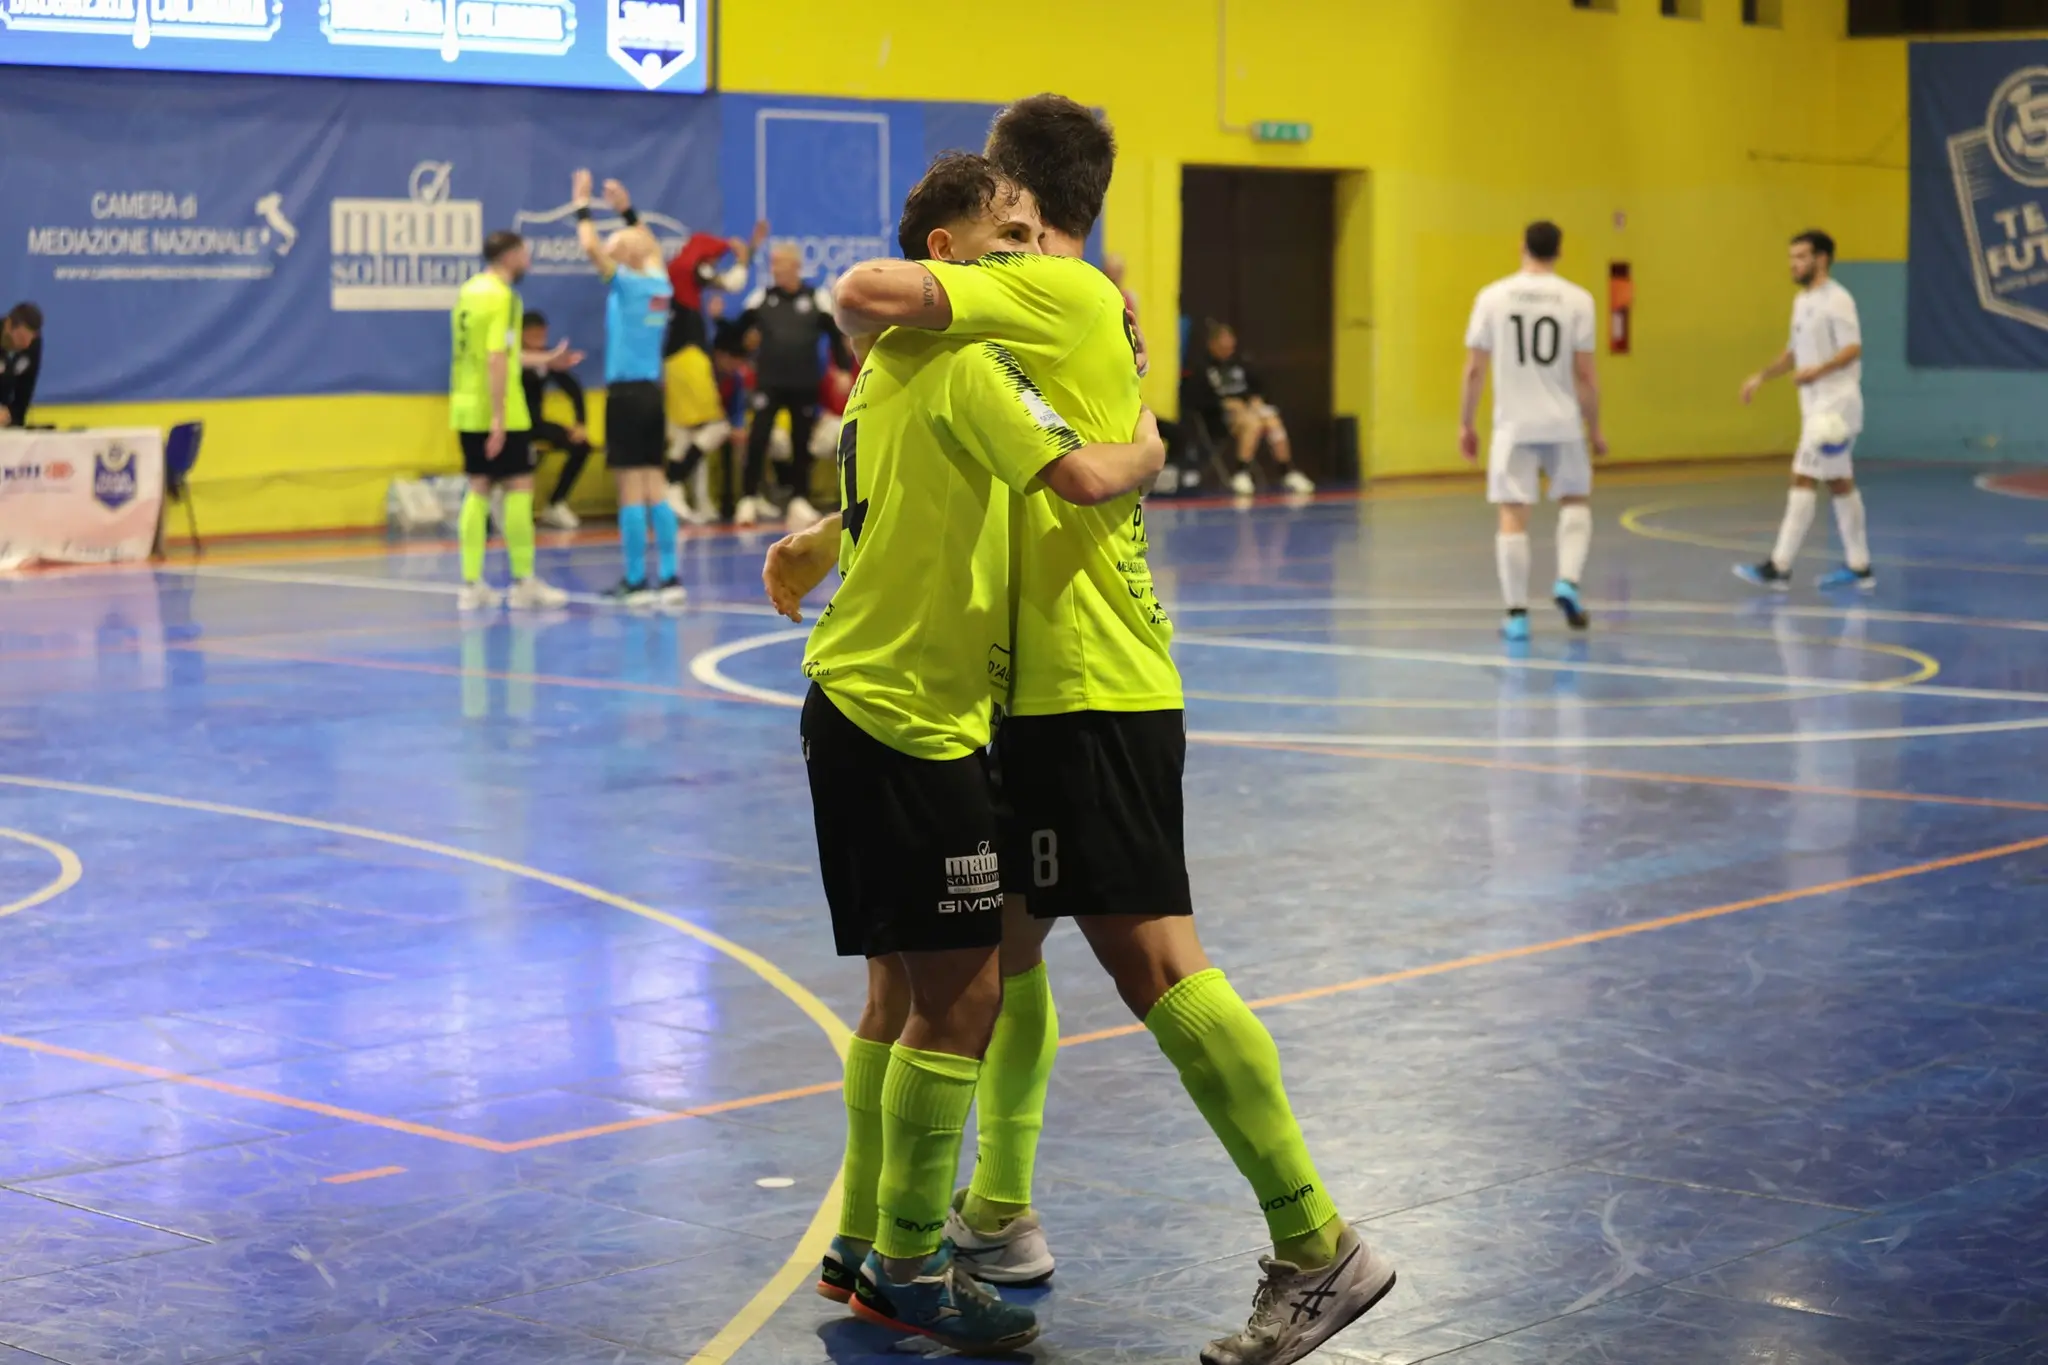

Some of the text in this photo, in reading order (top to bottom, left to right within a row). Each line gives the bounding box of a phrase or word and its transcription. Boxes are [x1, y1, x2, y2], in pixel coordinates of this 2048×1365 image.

[91, 190, 198, 219] CAMERA di
[28, 227, 258, 255] MEDIAZIONE NAZIONALE
[340, 205, 476, 255] main
[1510, 314, 1560, 367] 10
[949, 855, 998, 877] main
[1031, 828, 1058, 888] 8
[946, 870, 1000, 887] solution
[938, 892, 1004, 913] GIVOVA
